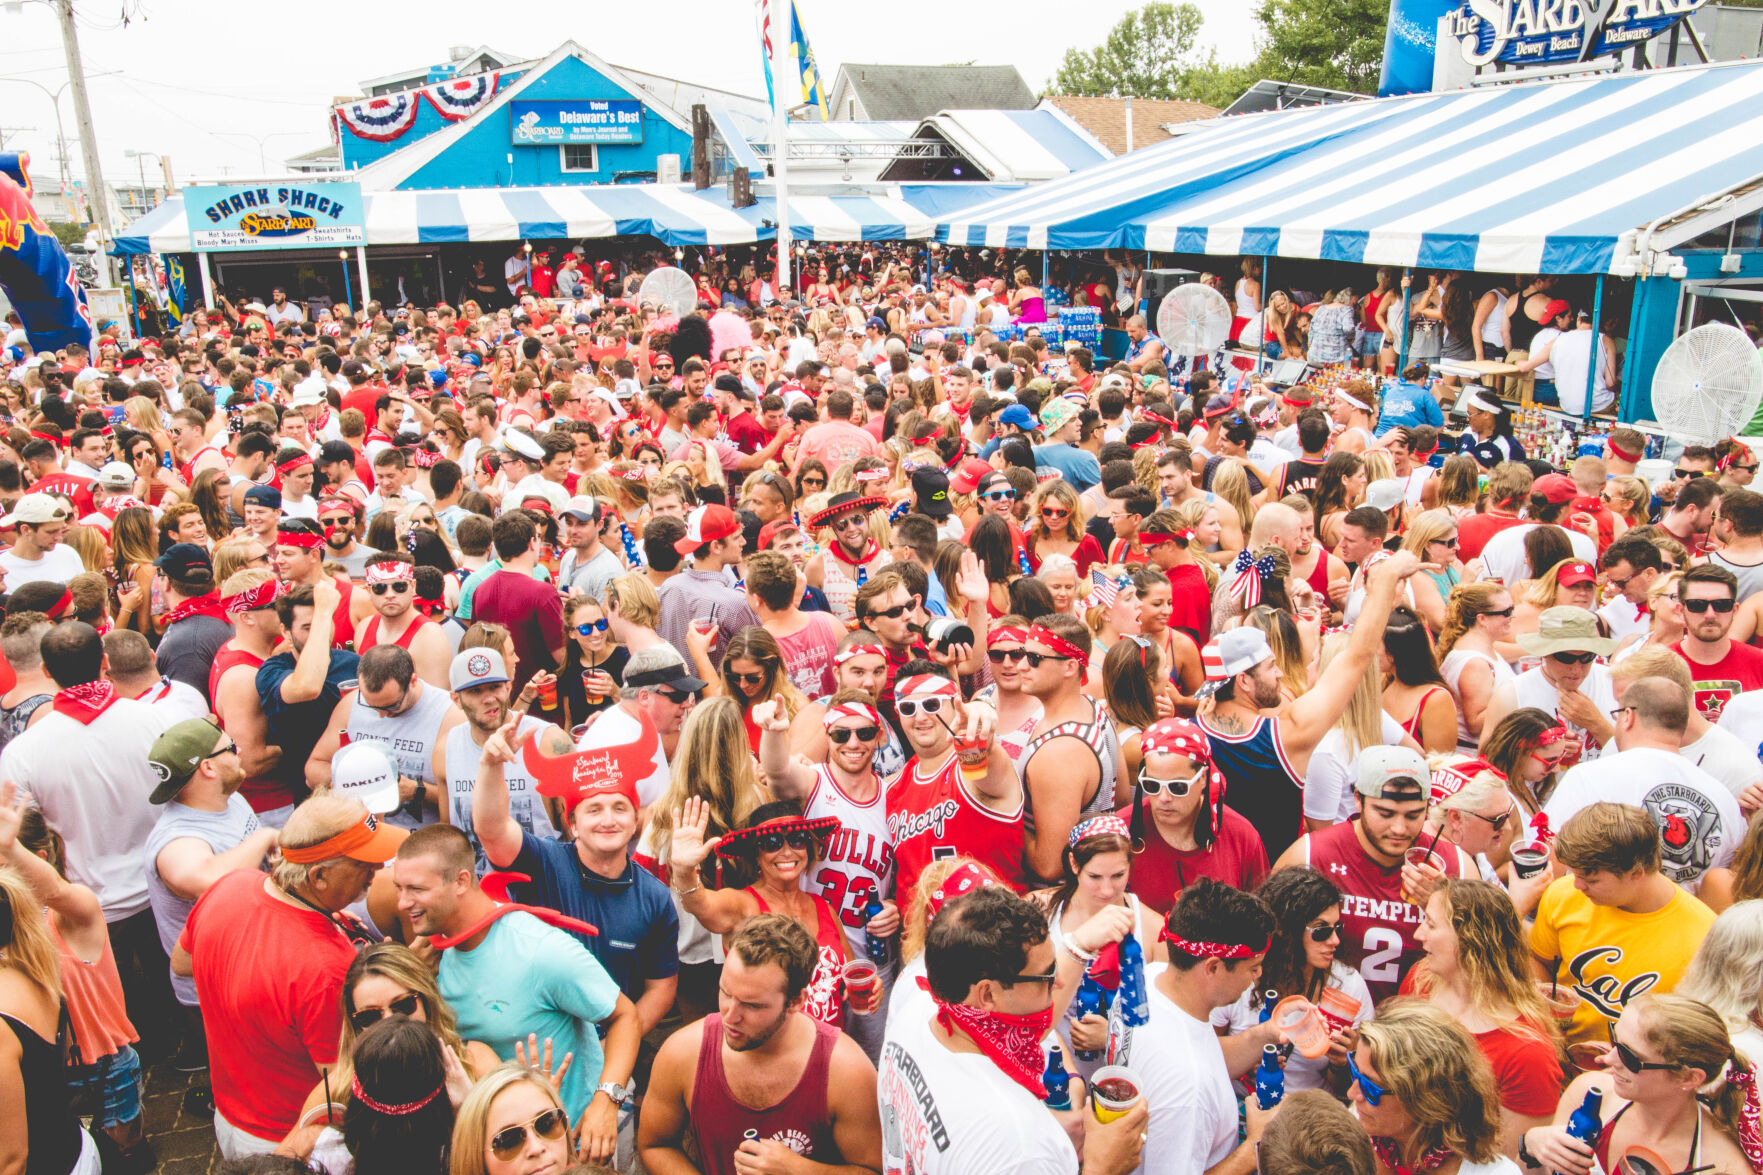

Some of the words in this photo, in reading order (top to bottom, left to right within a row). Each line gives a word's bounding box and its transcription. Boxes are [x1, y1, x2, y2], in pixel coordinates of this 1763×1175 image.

[1445, 8, 1480, 37] The
[1516, 41, 1545, 57] Dewey
[1551, 37, 1579, 52] Beach
[1605, 28, 1651, 45] Delaware
[559, 111, 615, 124] Delaware's
[617, 111, 640, 124] Best
[590, 101, 609, 111] Voted
[205, 188, 271, 224] SHARK
[277, 187, 345, 220] SHACK
[197, 239, 219, 248] Bloody
[221, 238, 237, 247] Mary
[306, 235, 335, 243] T-Shirts
[346, 233, 362, 241] Hats
[208, 231, 220, 239] Hot
[222, 230, 245, 238] Sauces
[313, 226, 352, 235] Sweatshirts
[38, 482, 79, 497] ELLY
[393, 738, 424, 754] FEED
[342, 774, 388, 789] OAKLEY
[1651, 787, 1667, 801] THE
[1666, 786, 1711, 813] STARBOARD
[887, 799, 960, 851] Chicago
[816, 867, 877, 929] 33
[1360, 926, 1403, 984] 2
[1569, 946, 1661, 1010] Cal
